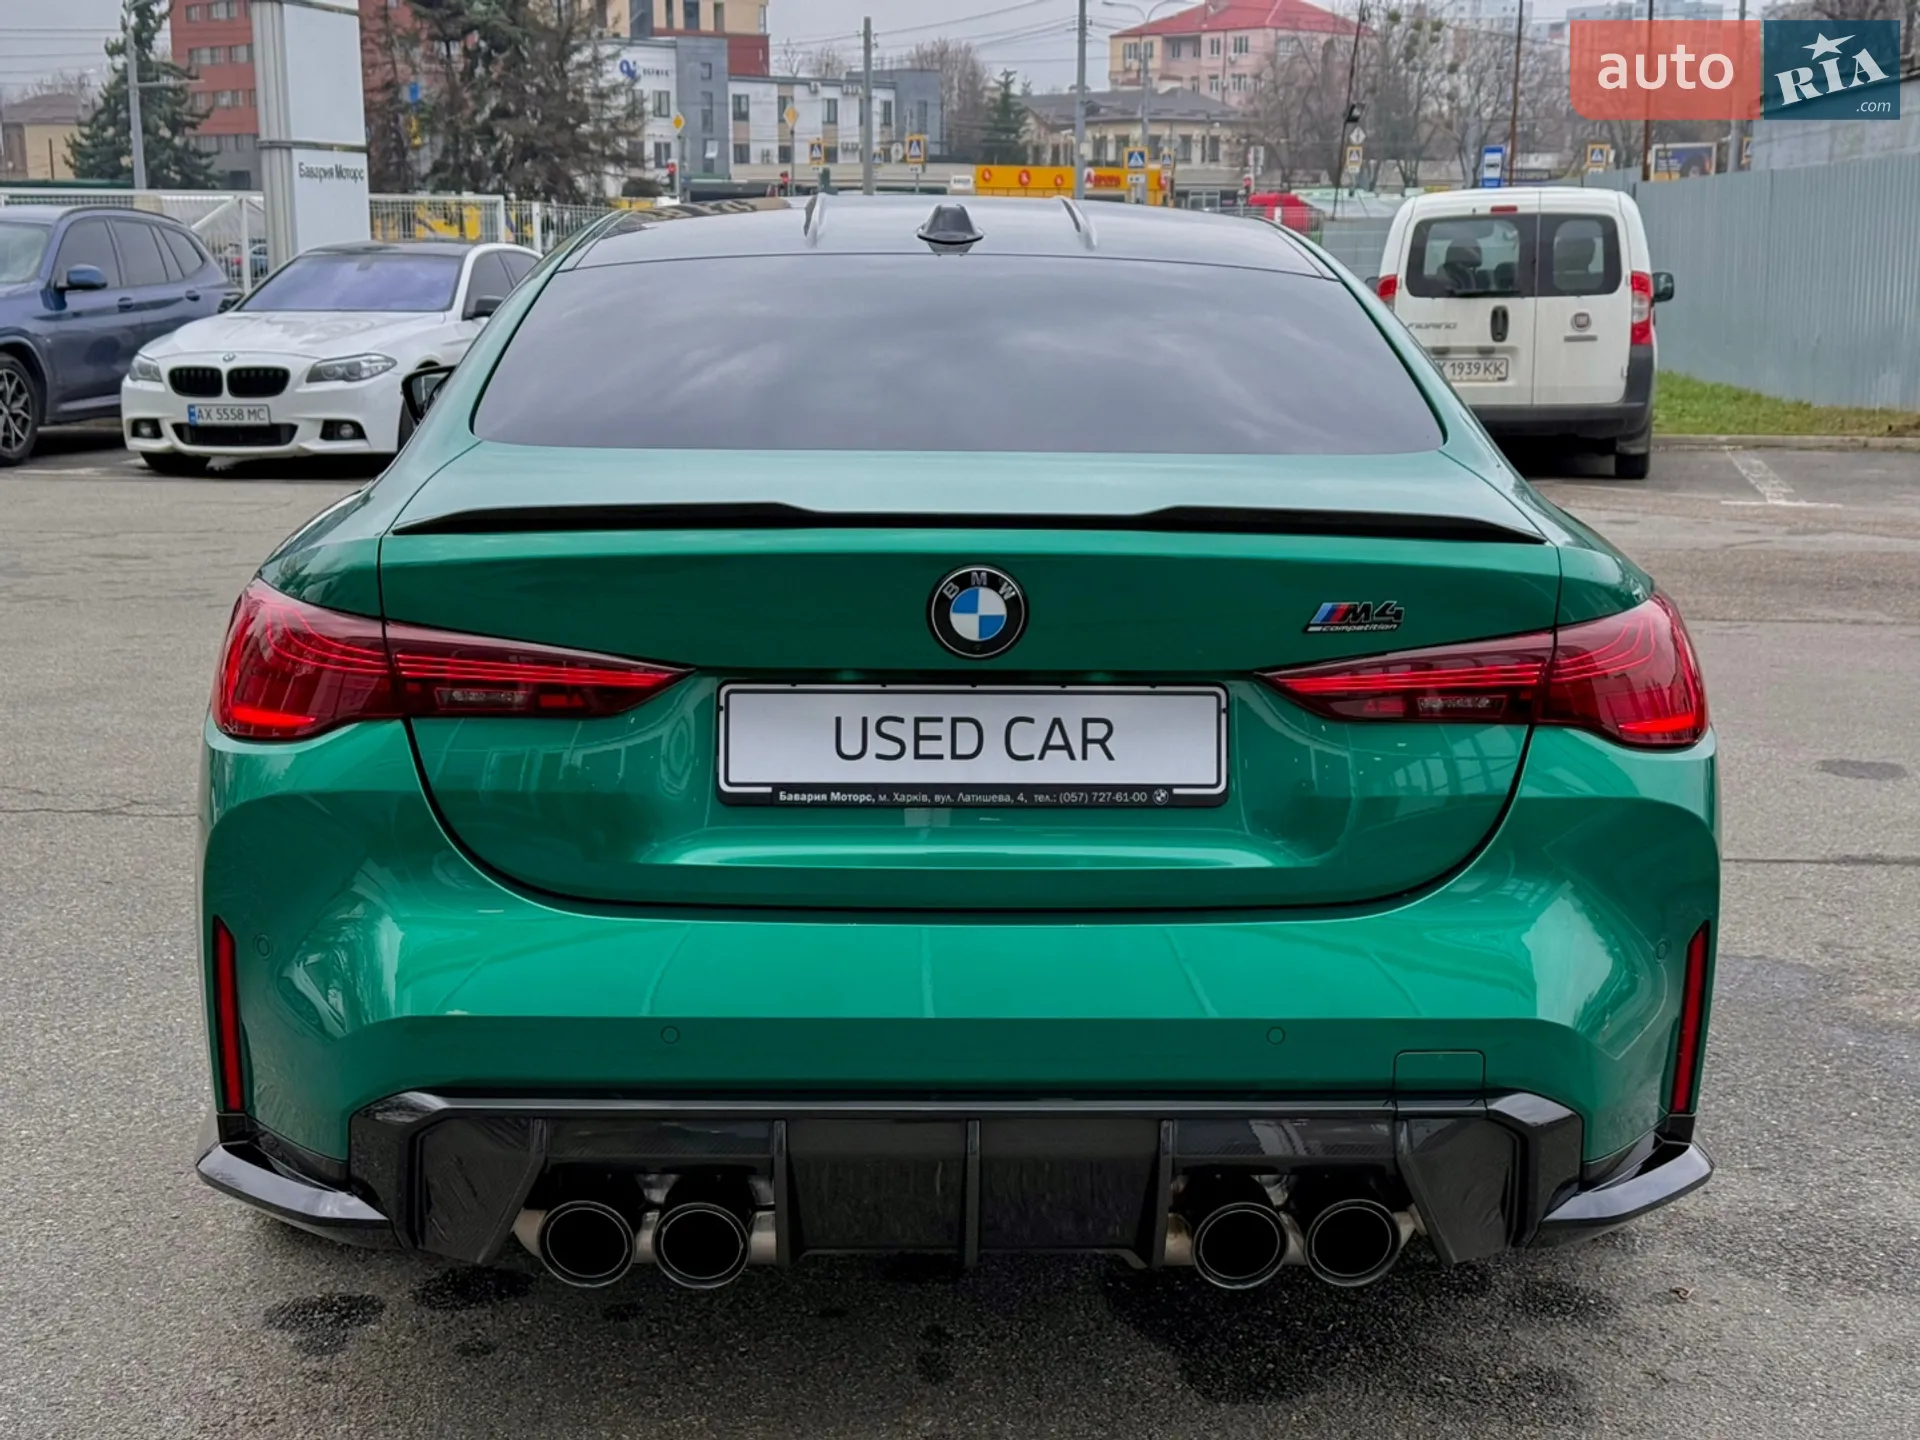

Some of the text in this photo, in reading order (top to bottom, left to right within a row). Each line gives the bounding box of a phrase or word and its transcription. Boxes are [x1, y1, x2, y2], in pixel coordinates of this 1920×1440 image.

[1450, 362, 1480, 375] 1939
[1483, 362, 1504, 375] KK
[197, 408, 266, 420] AX 5558 MC
[942, 571, 1016, 600] BMW
[1326, 600, 1405, 623] M4
[834, 715, 1115, 761] USED CAR
[779, 791, 827, 804] Бавария
[830, 791, 876, 804] Моторс,
[893, 791, 931, 804] Харків,
[1059, 791, 1088, 804] (057)
[1092, 791, 1148, 803] 727-61-00
